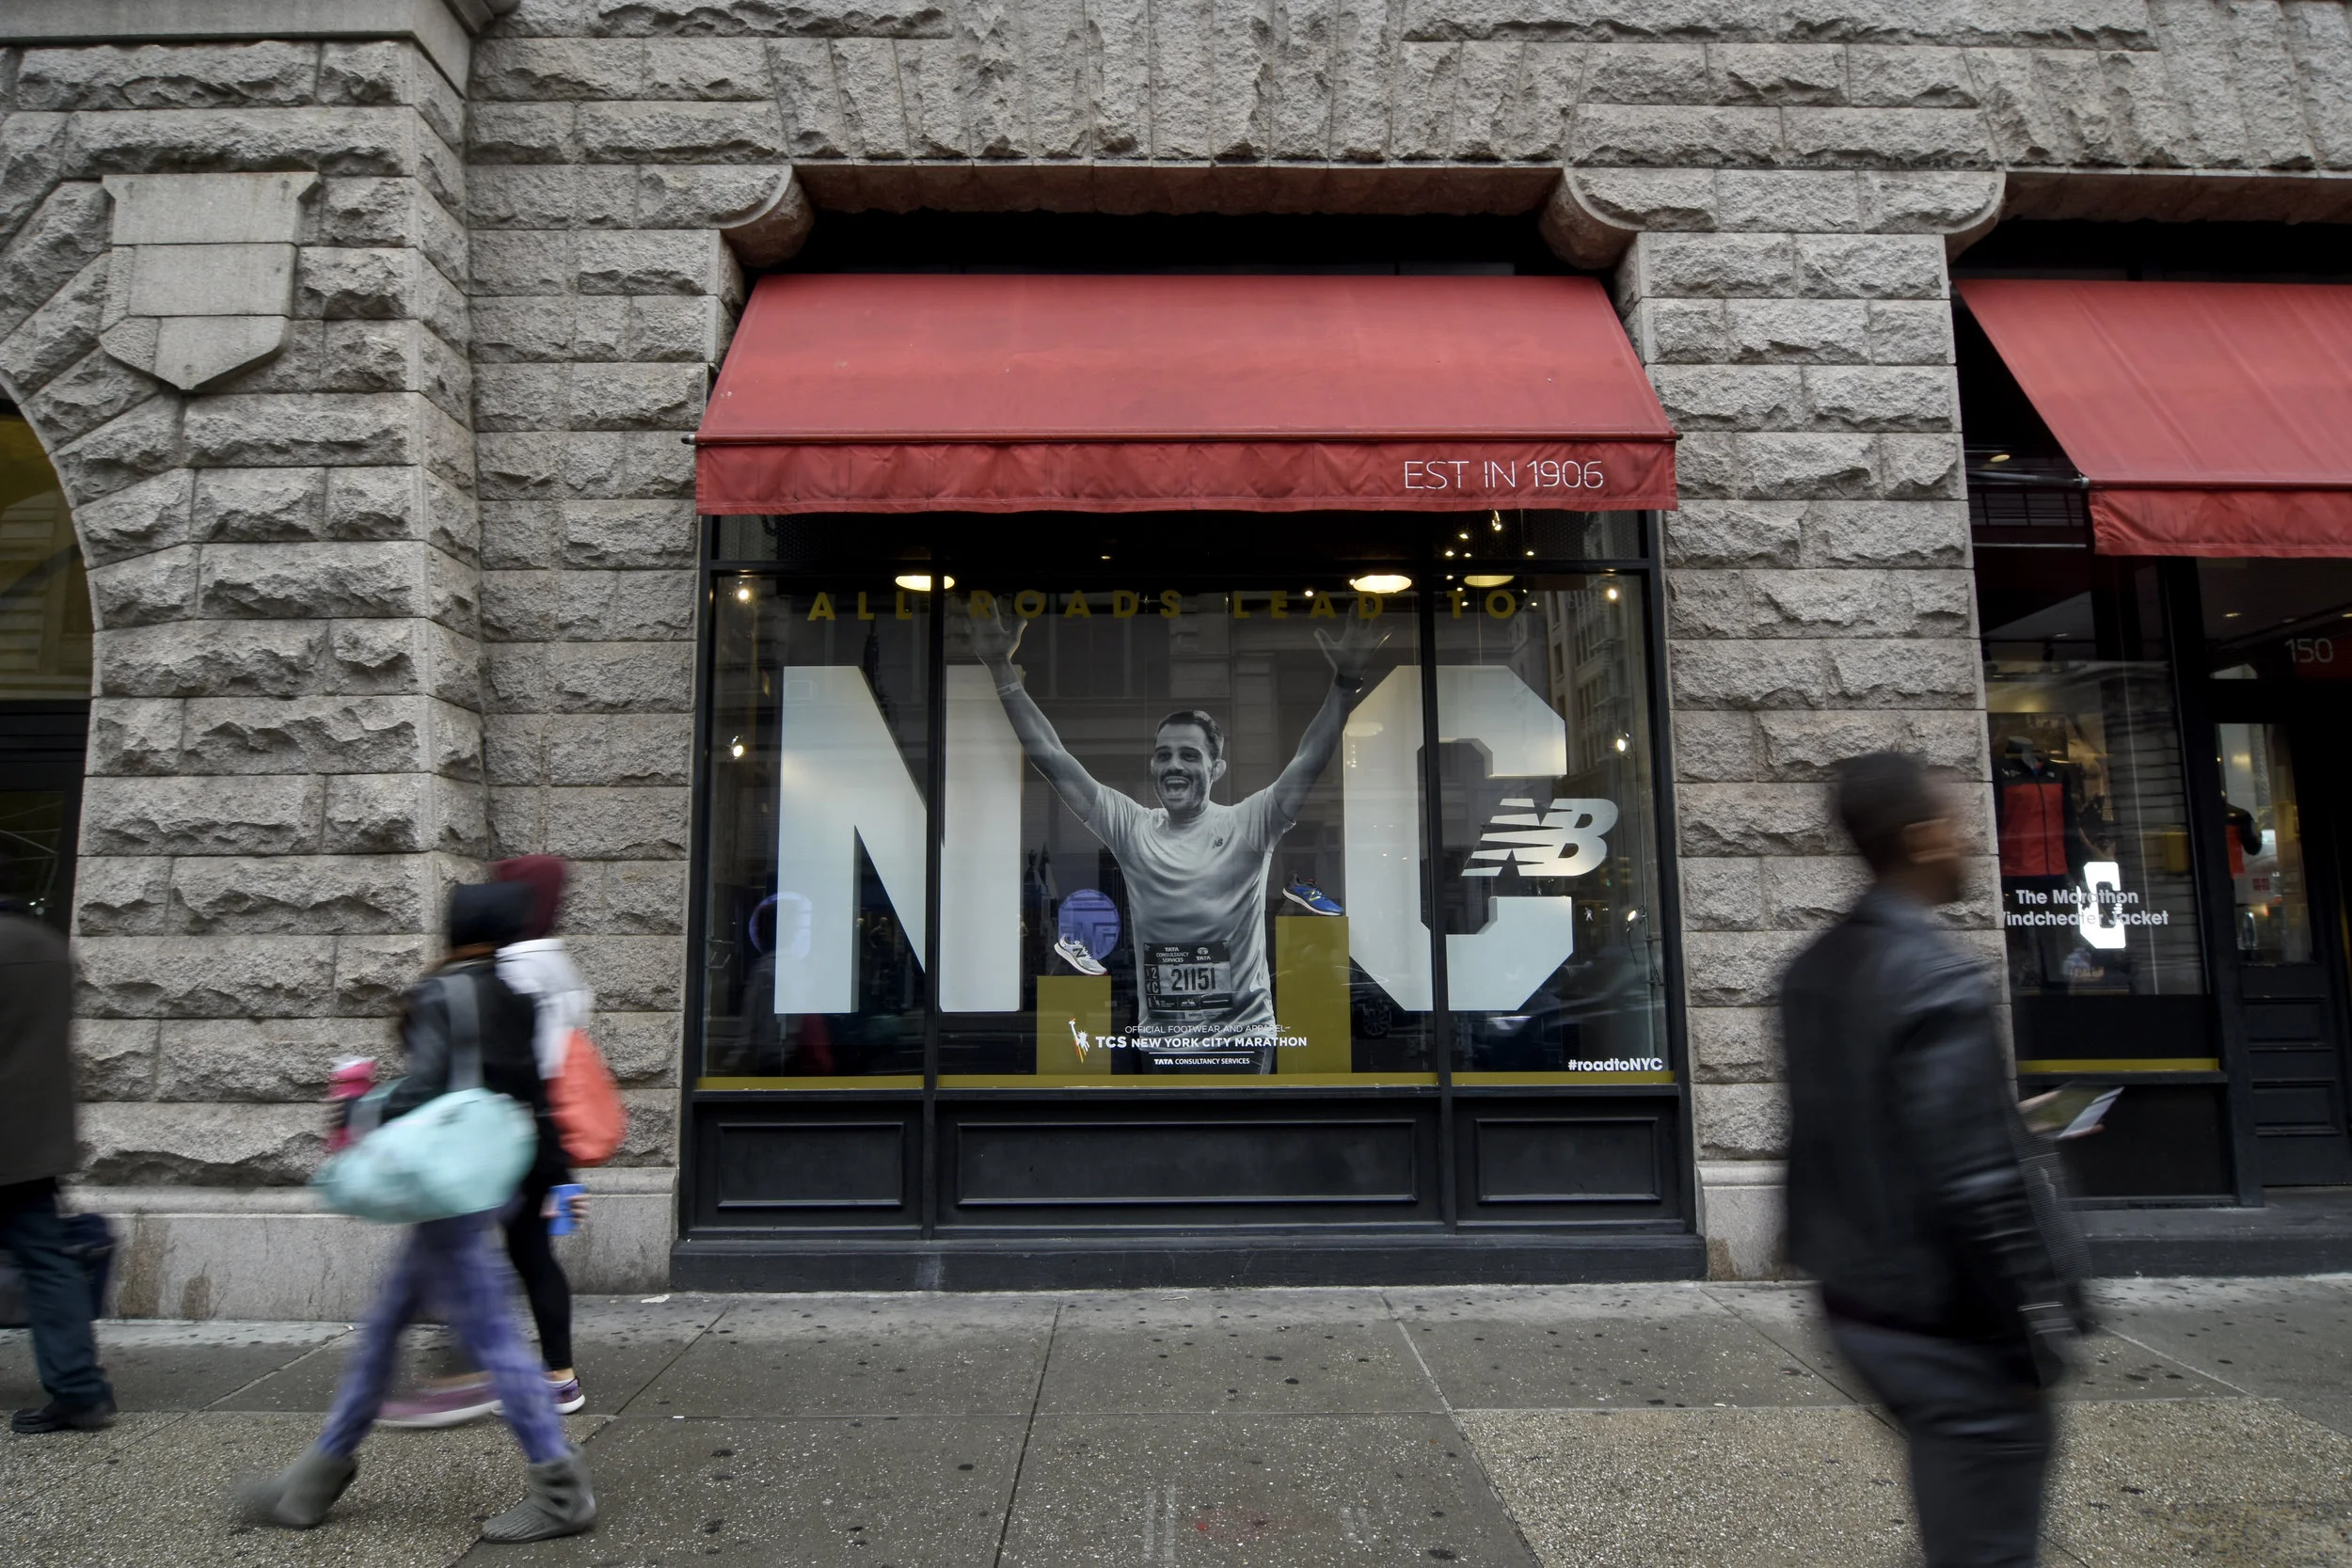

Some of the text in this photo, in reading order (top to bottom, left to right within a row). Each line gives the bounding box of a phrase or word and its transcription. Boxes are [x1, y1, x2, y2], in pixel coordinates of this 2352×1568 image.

[1404, 460, 1604, 490] EST IN 1906
[806, 589, 1517, 622] ALL ROADS LEAD TO
[2283, 638, 2334, 664] 150
[2015, 888, 2139, 905] The Marathon
[2003, 910, 2169, 927] indcheater Jacket
[1170, 966, 1216, 991] 21151
[1124, 1025, 1167, 1034] OFFICIAL
[1168, 1024, 1221, 1034] FOOTWEAR
[1222, 1024, 1244, 1033] AND
[1095, 1036, 1308, 1049] TCS NEW YORK CITY MARATHON
[1567, 1056, 1663, 1071] #roadtoNYC
